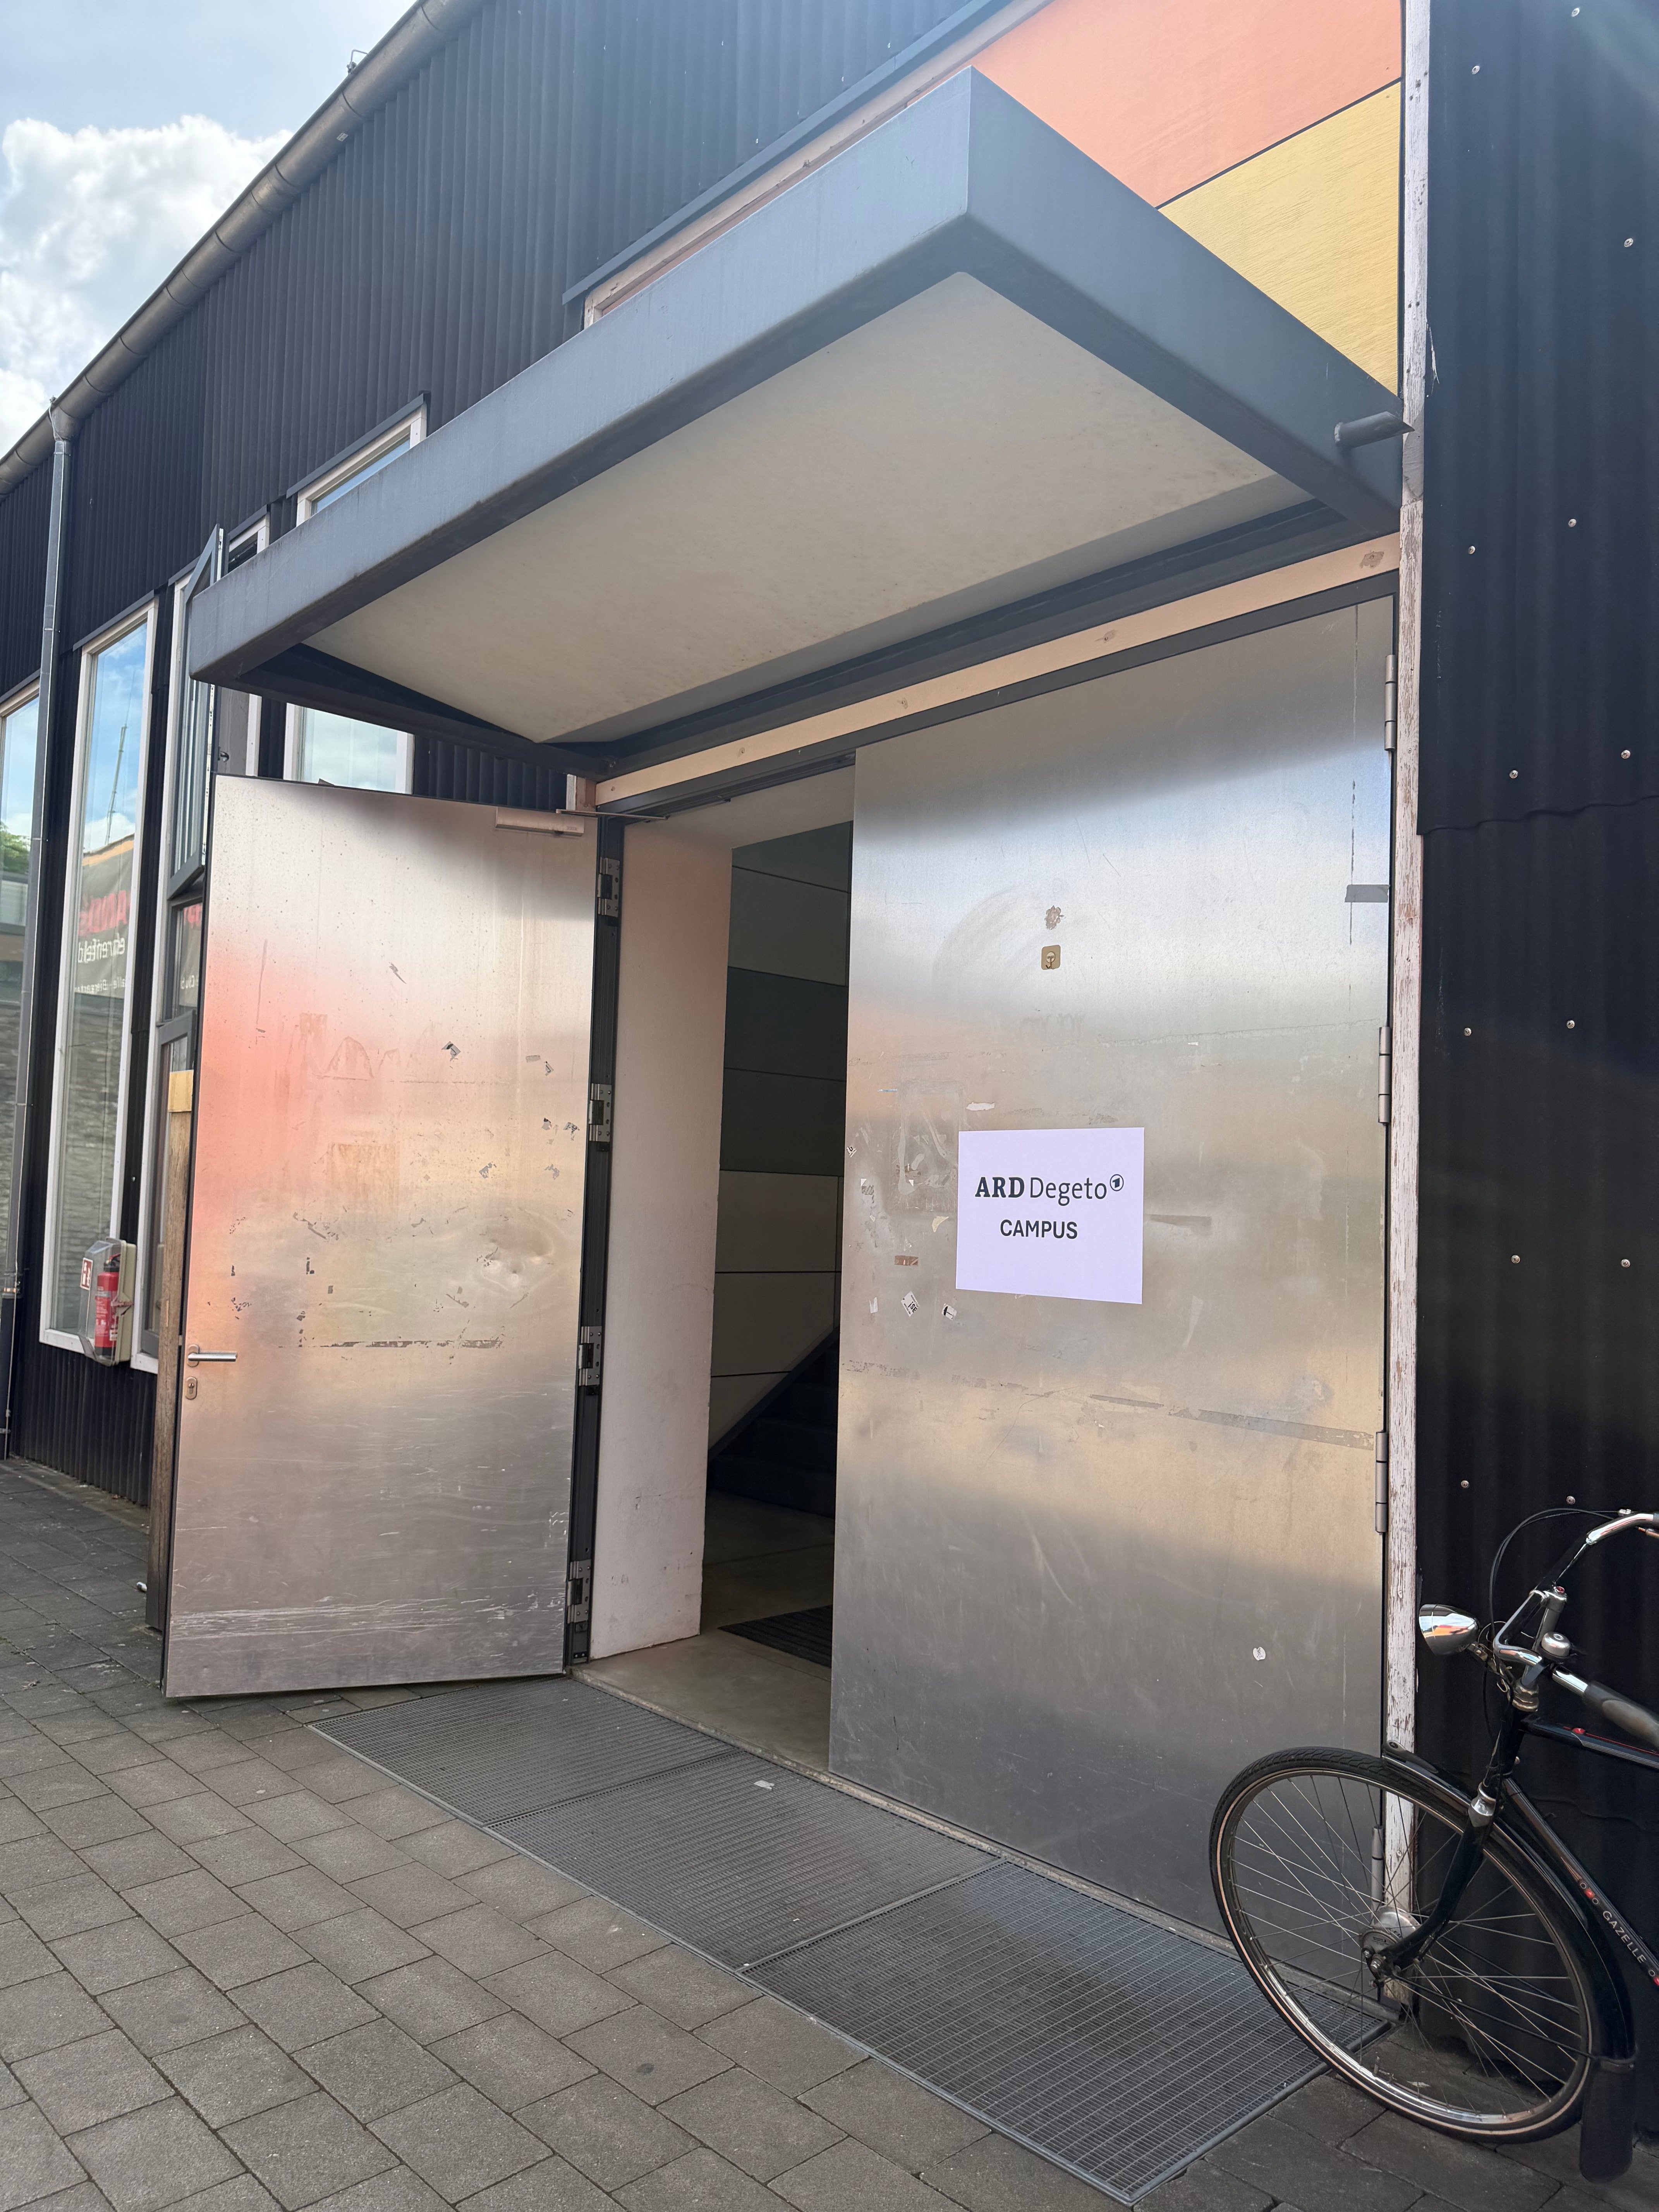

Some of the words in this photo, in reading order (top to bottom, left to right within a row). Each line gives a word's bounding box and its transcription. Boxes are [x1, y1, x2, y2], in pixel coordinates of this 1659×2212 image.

[975, 1176, 1025, 1198] ARD
[1030, 1177, 1107, 1206] Degeto
[1000, 1219, 1078, 1239] CAMPUS
[1602, 1910, 1647, 1964] GAZELLE
